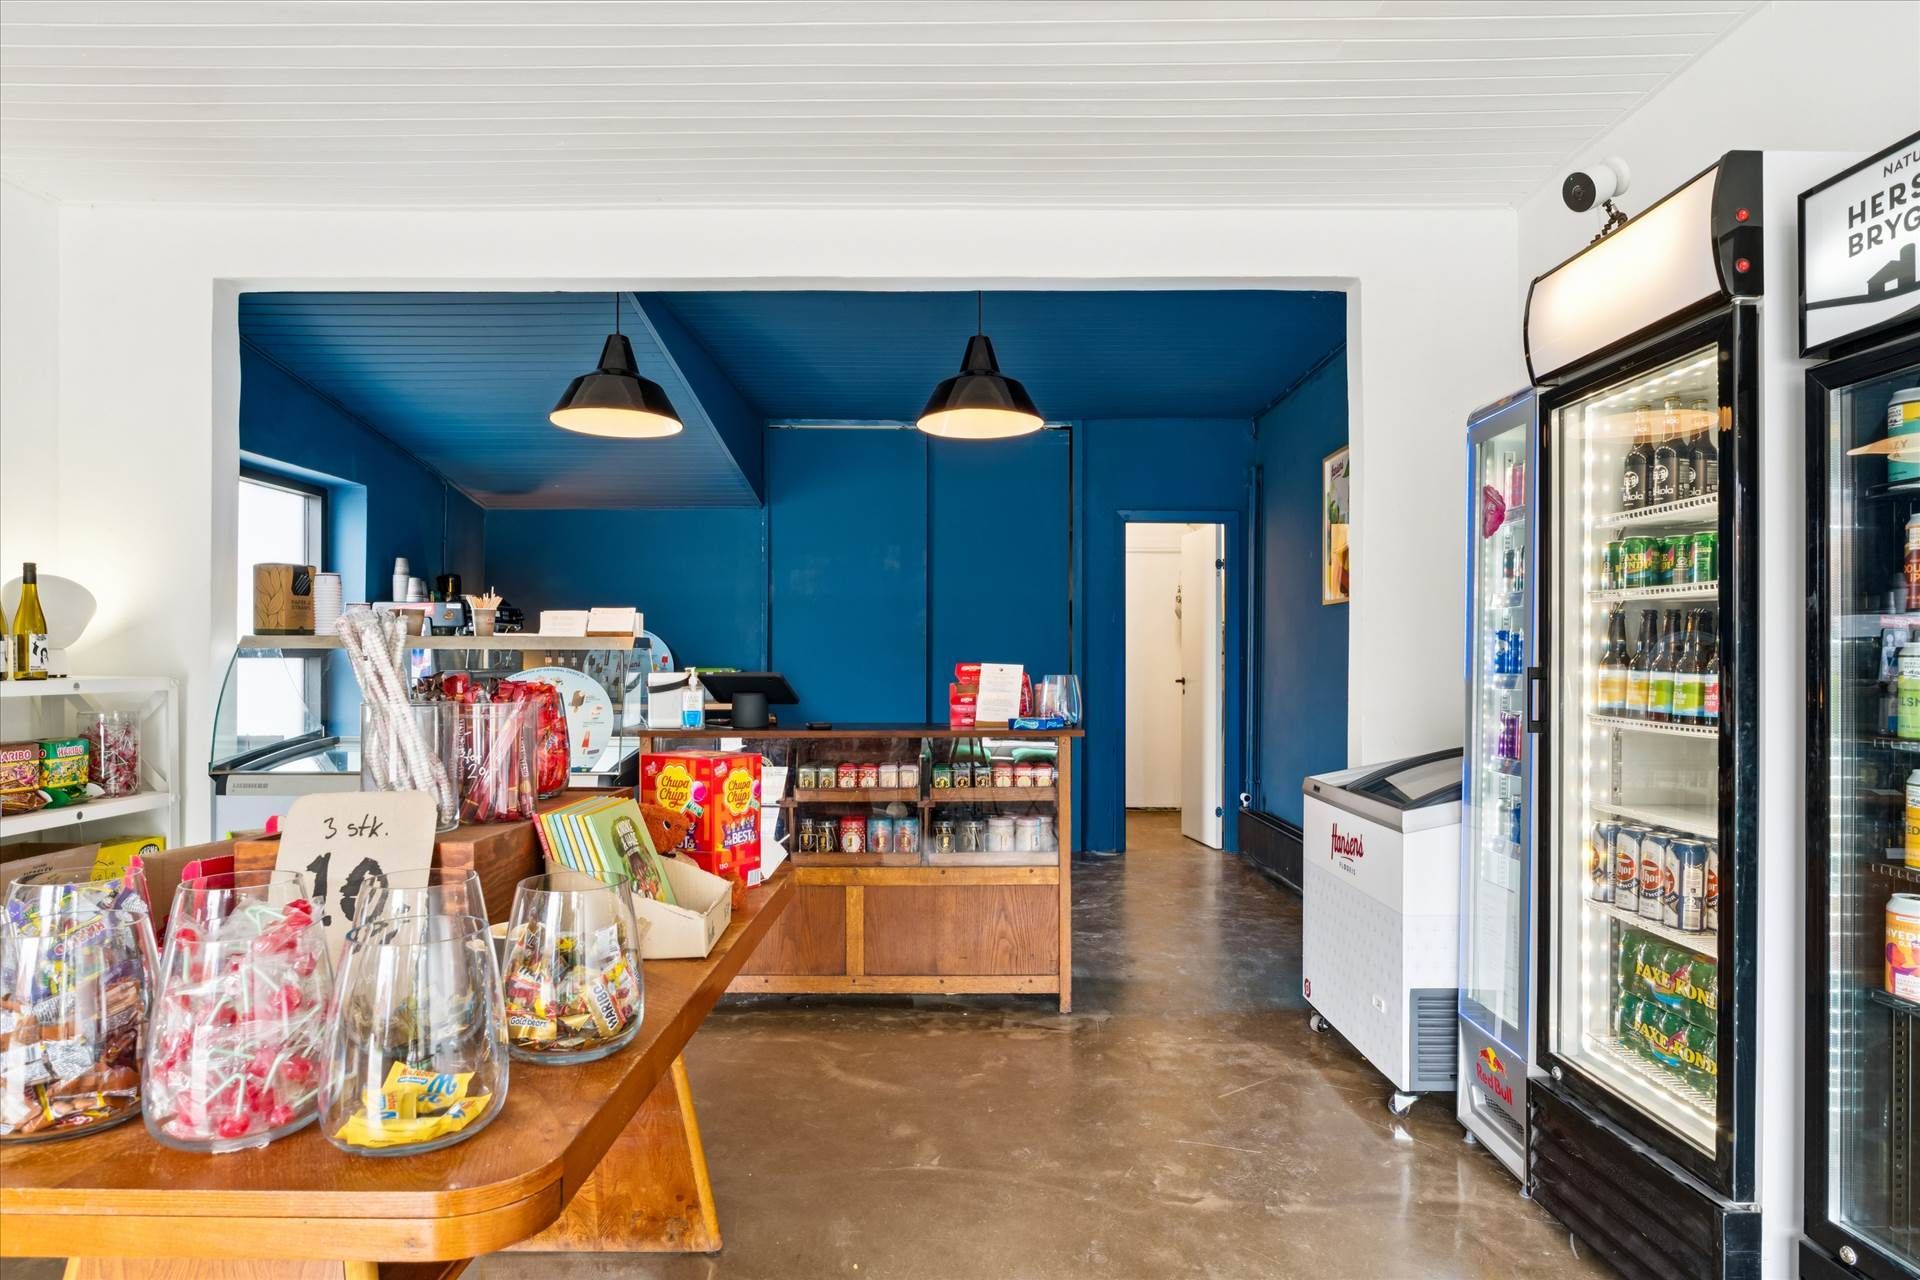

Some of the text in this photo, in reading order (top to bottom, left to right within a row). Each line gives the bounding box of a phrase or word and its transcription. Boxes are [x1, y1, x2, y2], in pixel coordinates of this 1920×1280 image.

[661, 775, 690, 790] Chupa
[728, 780, 751, 794] Chupa
[660, 788, 689, 803] Chups
[727, 790, 751, 805] Chups
[323, 814, 389, 839] 3 stk.
[732, 829, 752, 844] BEST
[1635, 960, 1671, 989] FAXE
[593, 982, 618, 1031] HARIBO
[1475, 1062, 1513, 1106] Red Bull
